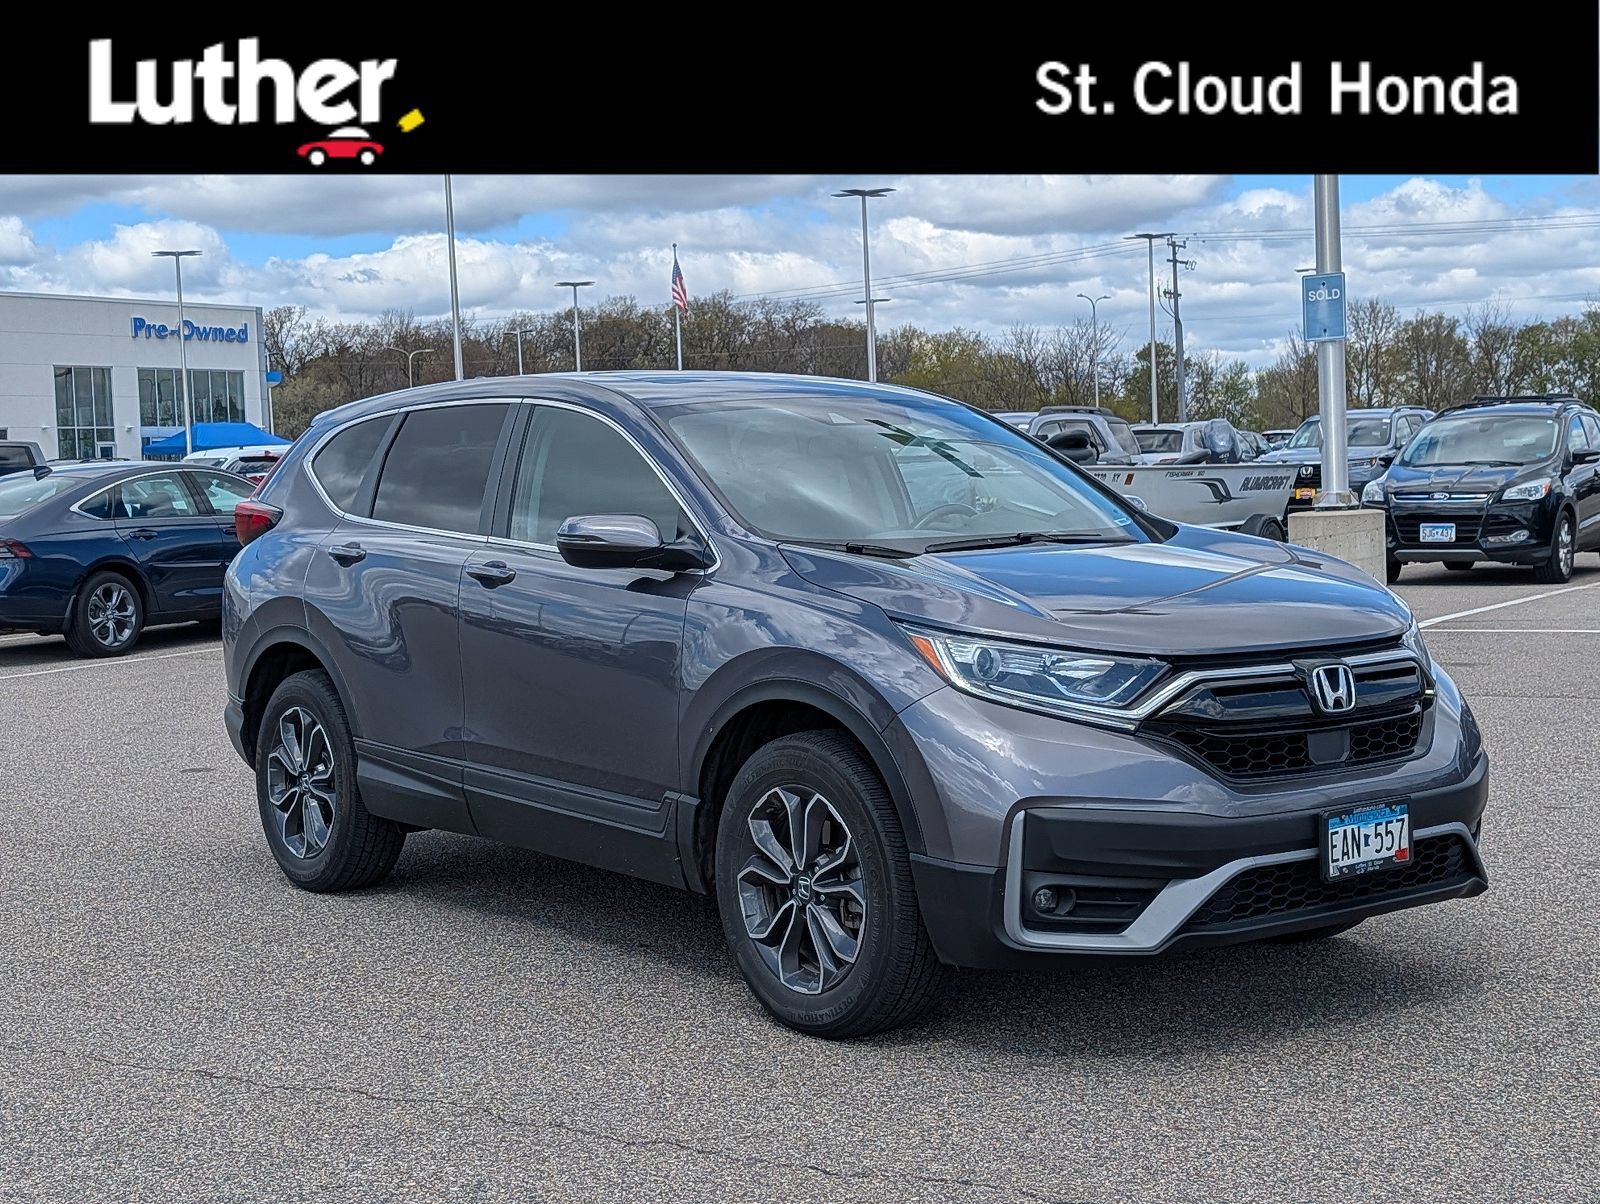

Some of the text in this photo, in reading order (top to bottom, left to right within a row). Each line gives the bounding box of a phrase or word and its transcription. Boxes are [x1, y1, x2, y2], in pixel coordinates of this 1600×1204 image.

[1308, 288, 1340, 302] SOLD
[131, 317, 249, 344] Pre-Owned
[1330, 818, 1405, 863] EAN 557
[800, 995, 855, 1022] DESTINATION
